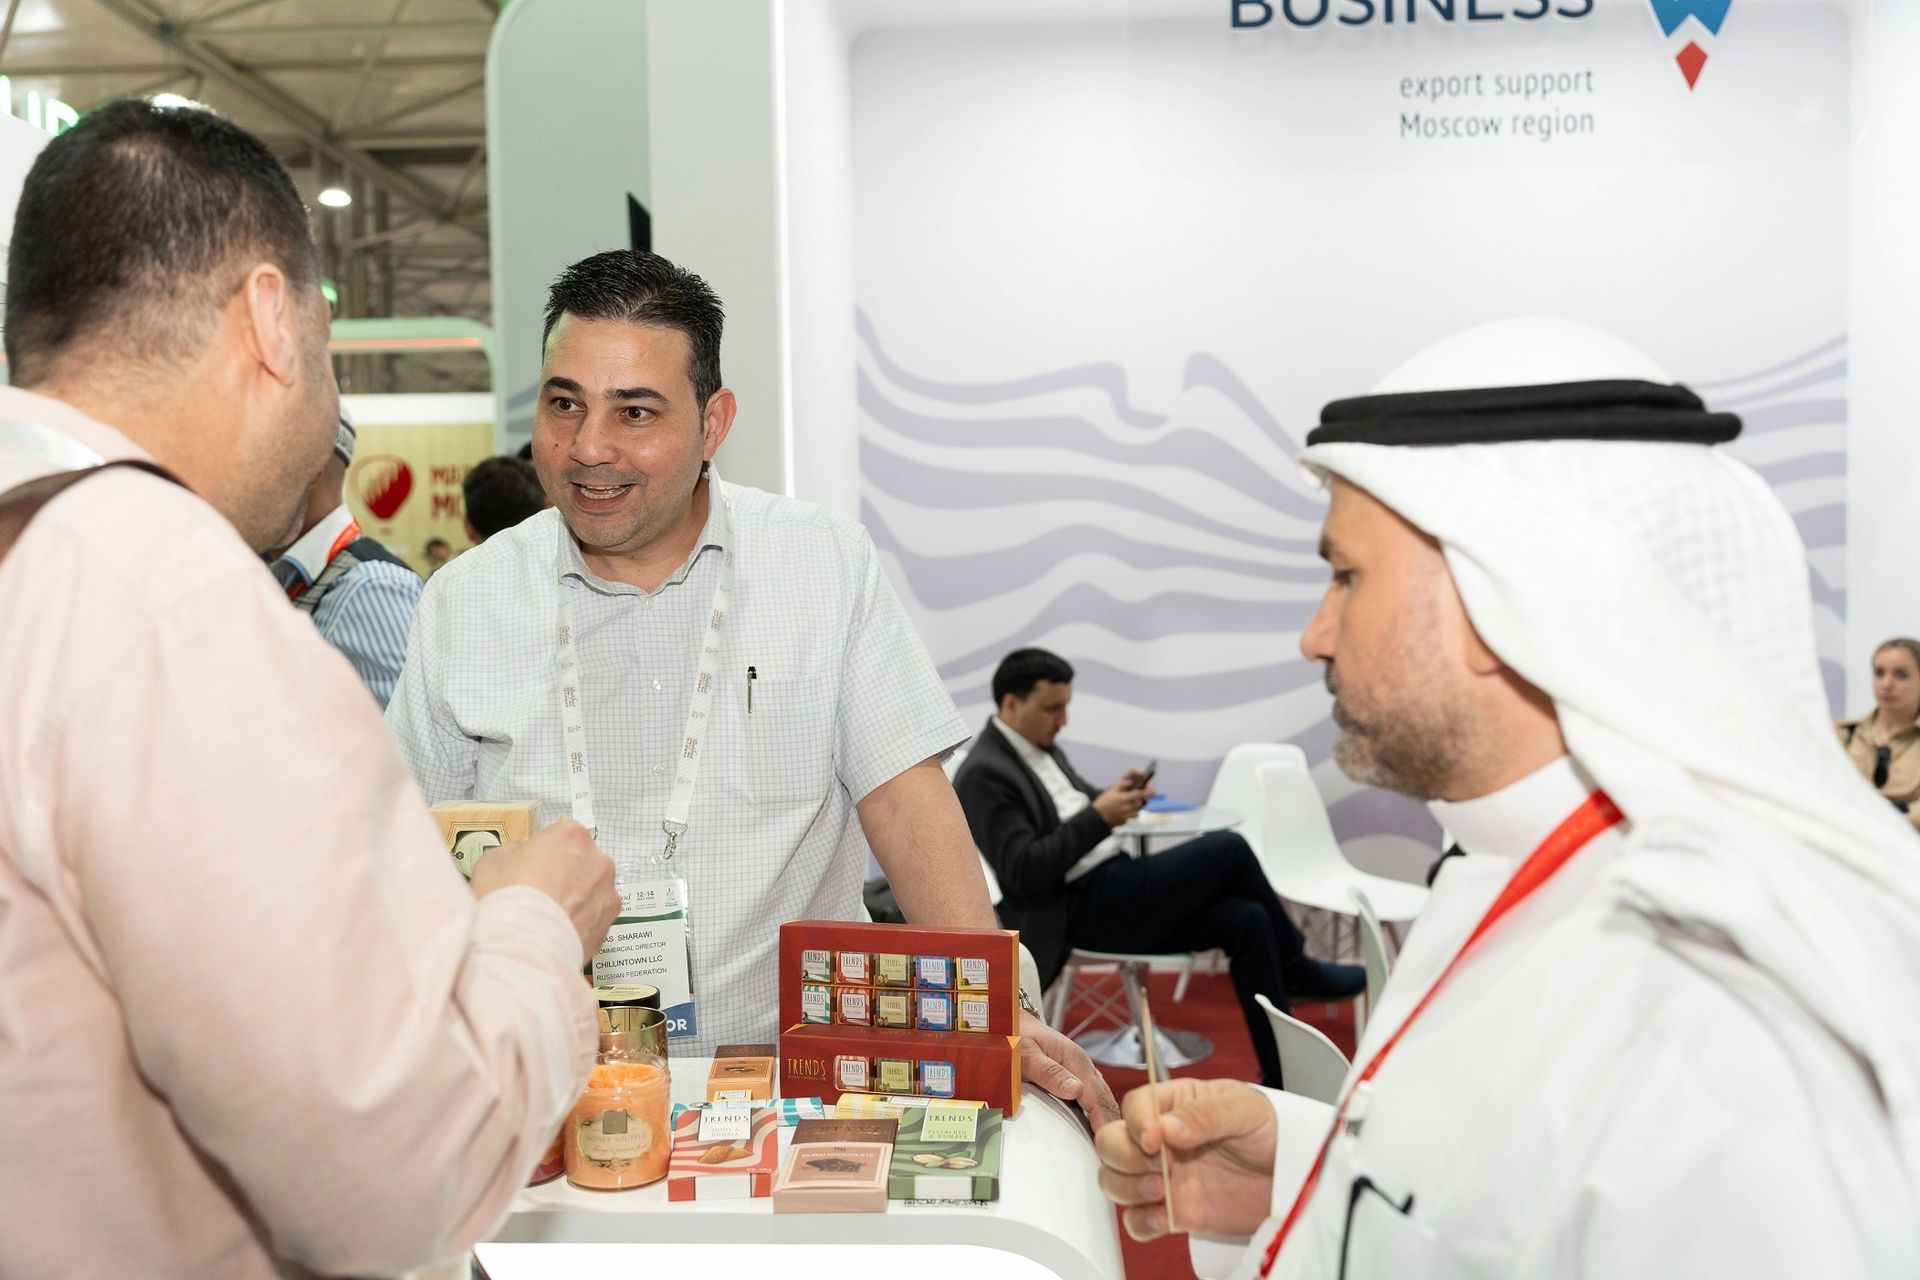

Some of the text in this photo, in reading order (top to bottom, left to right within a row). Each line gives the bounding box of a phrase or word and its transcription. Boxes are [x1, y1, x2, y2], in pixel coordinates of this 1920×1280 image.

[1400, 70, 1594, 102] export support
[1400, 107, 1595, 142] Moscow region
[617, 931, 653, 942] SHARAWI
[596, 941, 667, 955] OMMERCIAL DIRECTOR
[595, 954, 663, 969] CHILLINTOWN LLC
[843, 955, 863, 966] TRENDS
[963, 960, 985, 970] TRENDS
[596, 967, 667, 981] RUSSIAN FEDERATION
[804, 992, 825, 1003] TRENDS
[843, 996, 864, 1007] TRENDS
[787, 1058, 826, 1077] TRENDS
[842, 1063, 864, 1074] TRENDS
[703, 1114, 749, 1123] TRENDS
[929, 1113, 974, 1123] TRENDS
